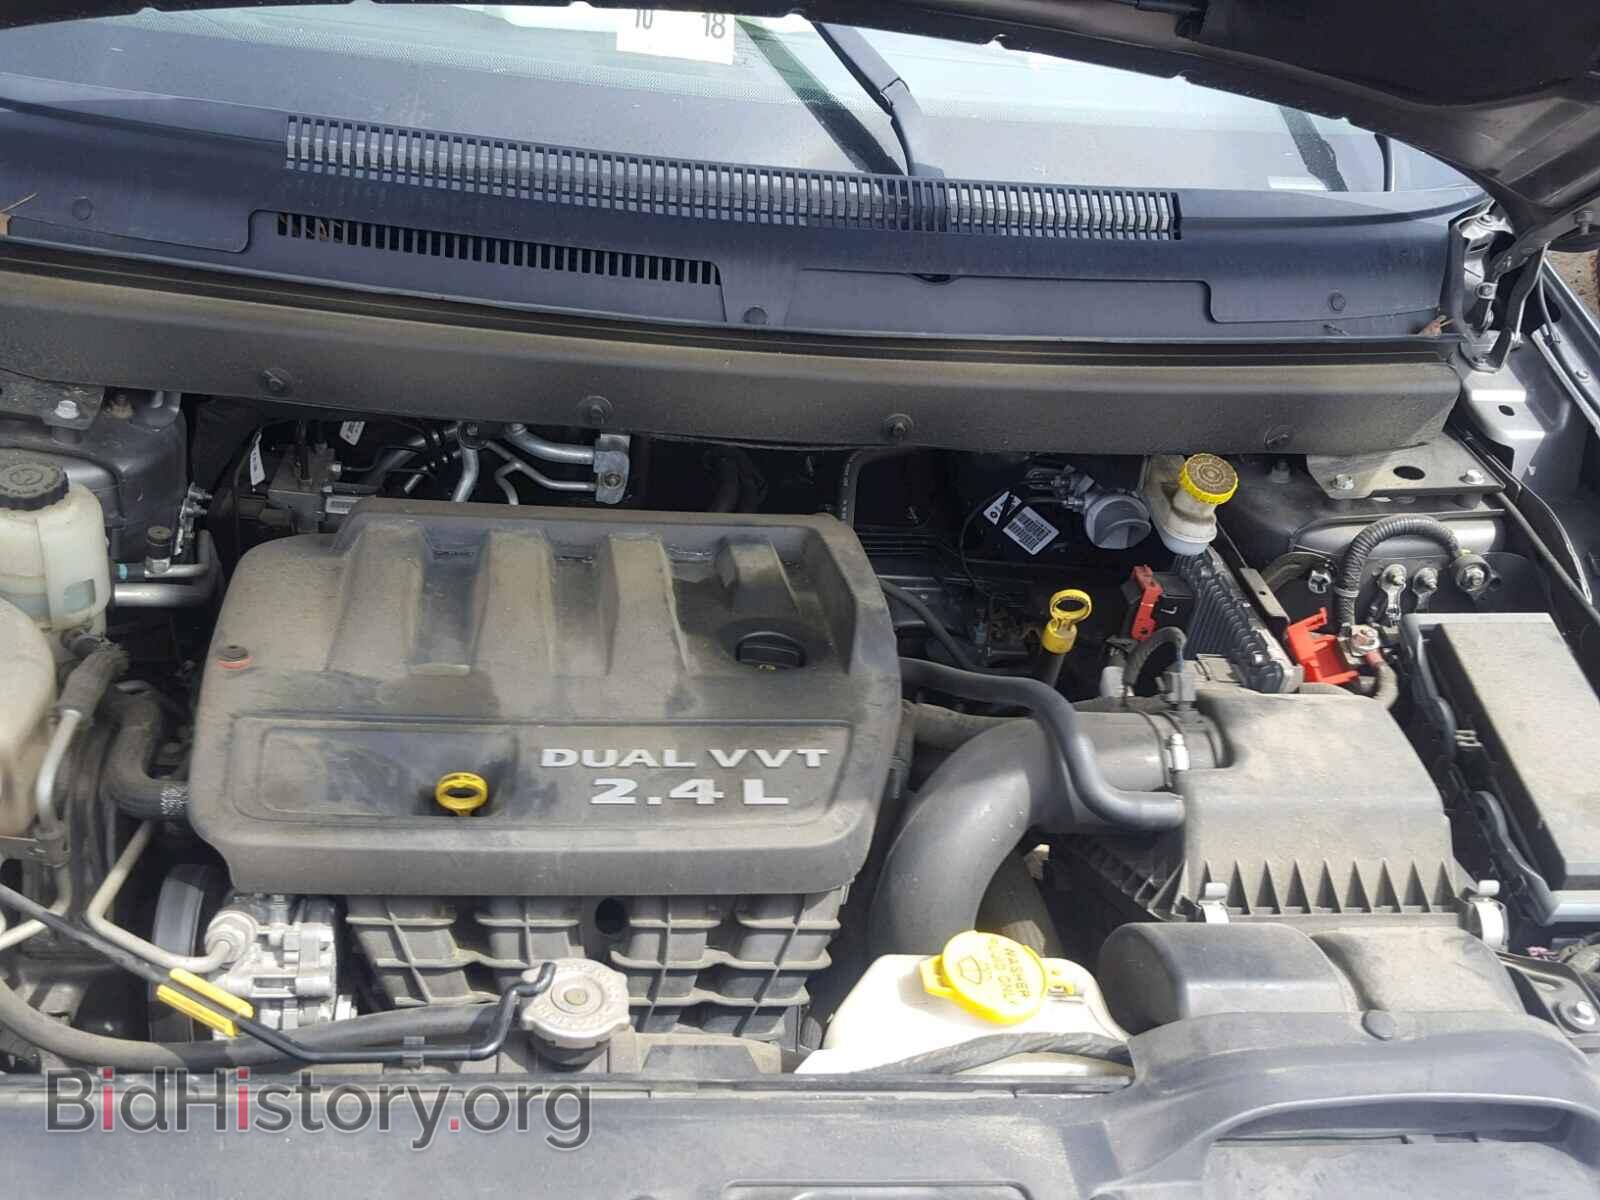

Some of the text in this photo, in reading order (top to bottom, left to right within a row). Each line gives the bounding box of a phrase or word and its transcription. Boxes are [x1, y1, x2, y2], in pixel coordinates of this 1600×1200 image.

[701, 13, 726, 39] 18
[541, 748, 829, 768] DUAL VVT
[590, 778, 789, 805] 2.4 L
[1004, 948, 1030, 998] WASHER
